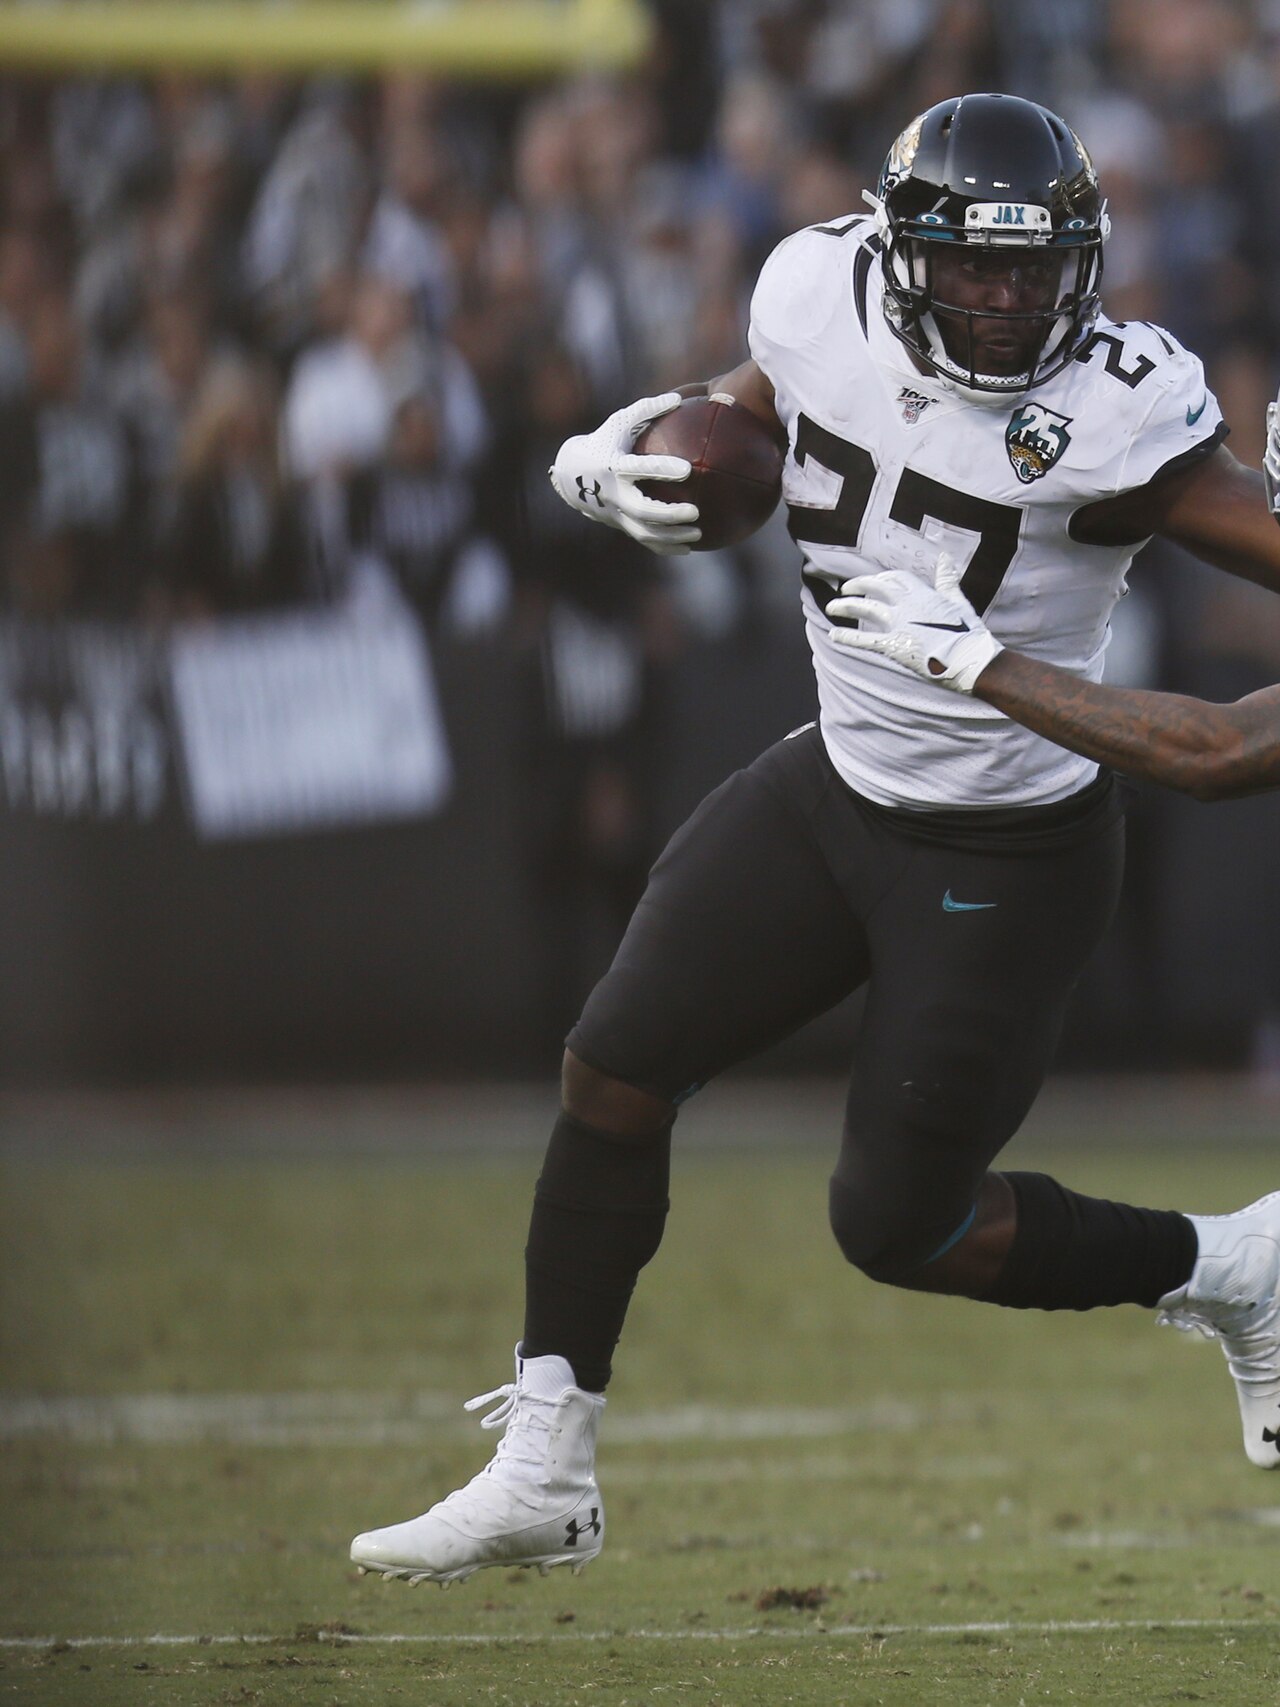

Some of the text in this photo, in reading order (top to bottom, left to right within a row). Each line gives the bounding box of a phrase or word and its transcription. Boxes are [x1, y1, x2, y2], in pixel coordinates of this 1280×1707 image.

[992, 205, 1025, 225] JAX
[1017, 404, 1069, 458] 25
[787, 411, 1025, 632] 27
